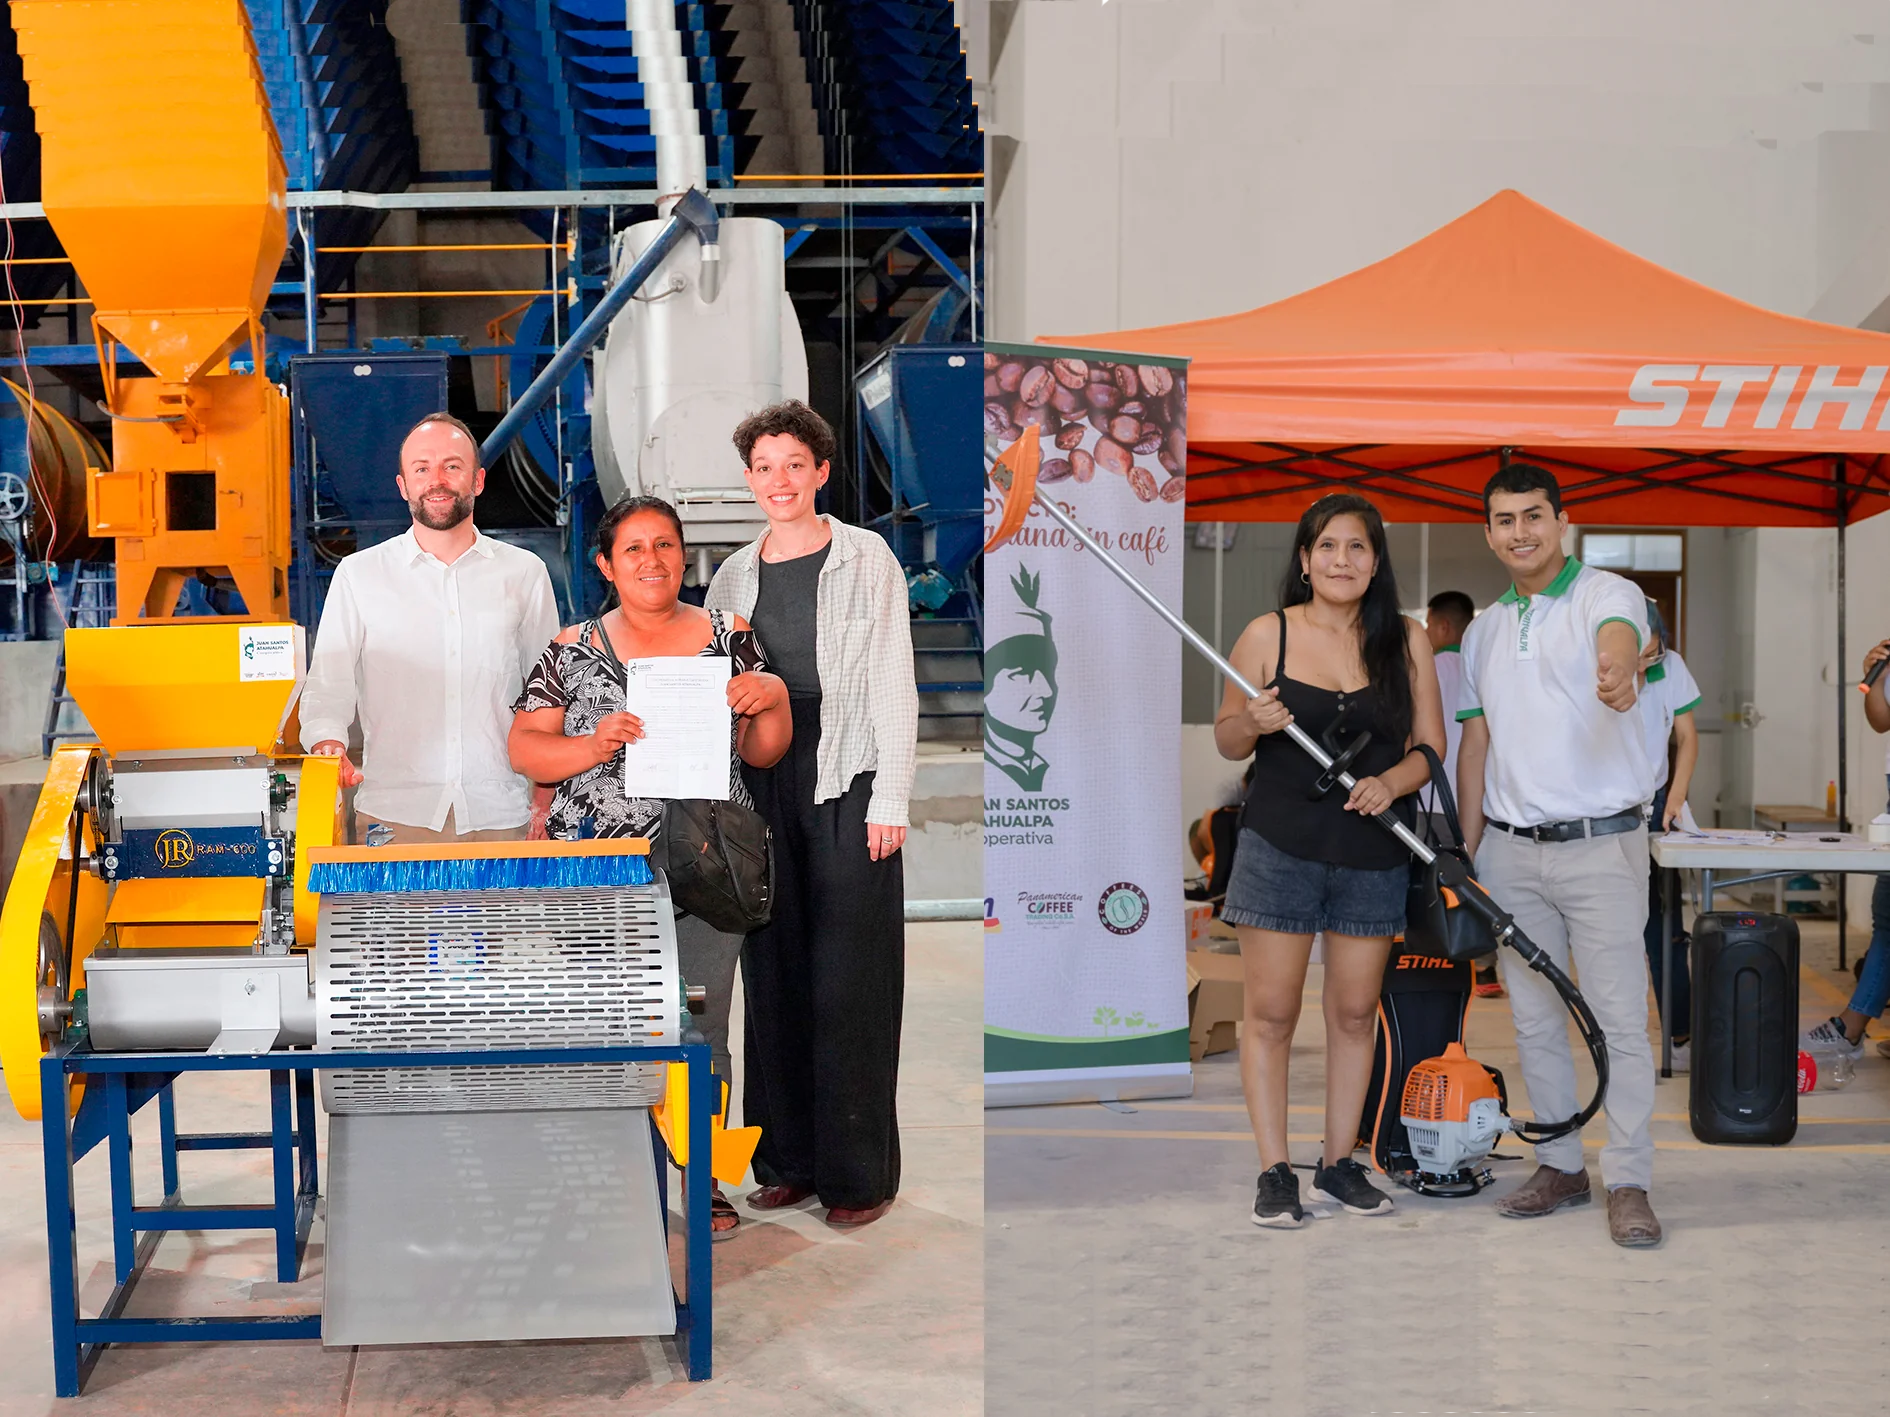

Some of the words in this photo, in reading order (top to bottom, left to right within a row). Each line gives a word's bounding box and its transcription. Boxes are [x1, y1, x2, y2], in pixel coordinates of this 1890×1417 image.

[1613, 363, 1890, 431] STIH
[1073, 527, 1114, 552] sn
[1118, 525, 1169, 566] café
[1006, 798, 1070, 811] SANTOS
[1017, 891, 1083, 905] Panamerican
[1027, 901, 1074, 914] COFFEE
